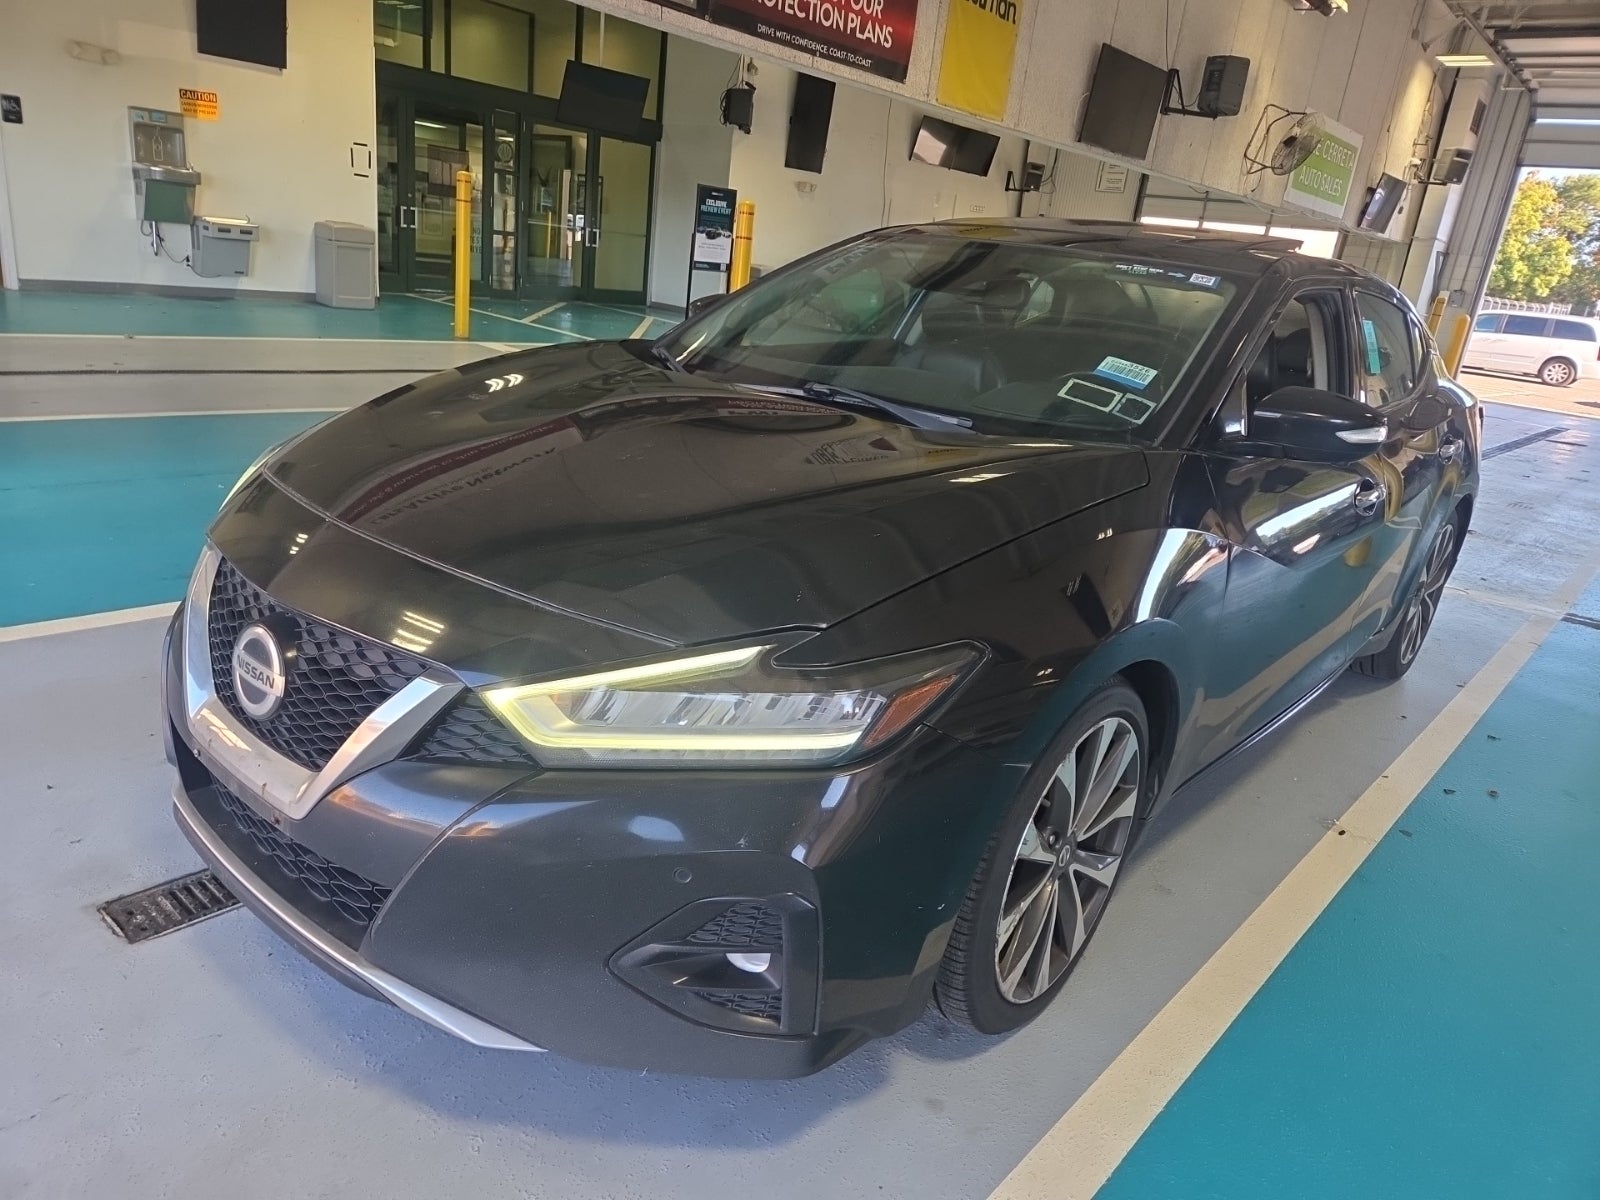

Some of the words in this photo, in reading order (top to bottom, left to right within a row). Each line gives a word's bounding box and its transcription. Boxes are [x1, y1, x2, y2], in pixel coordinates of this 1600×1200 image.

[842, 0, 884, 19] OUR
[752, 0, 845, 31] ECTION
[847, 12, 894, 48] PLANS
[757, 23, 775, 37] DRIVE
[775, 29, 791, 44] WITH
[180, 90, 216, 101] CAUTION
[1323, 140, 1355, 168] CERRETA
[1300, 165, 1321, 189] AUTO
[1321, 174, 1342, 196] SALES
[237, 654, 275, 689] NISSAN
